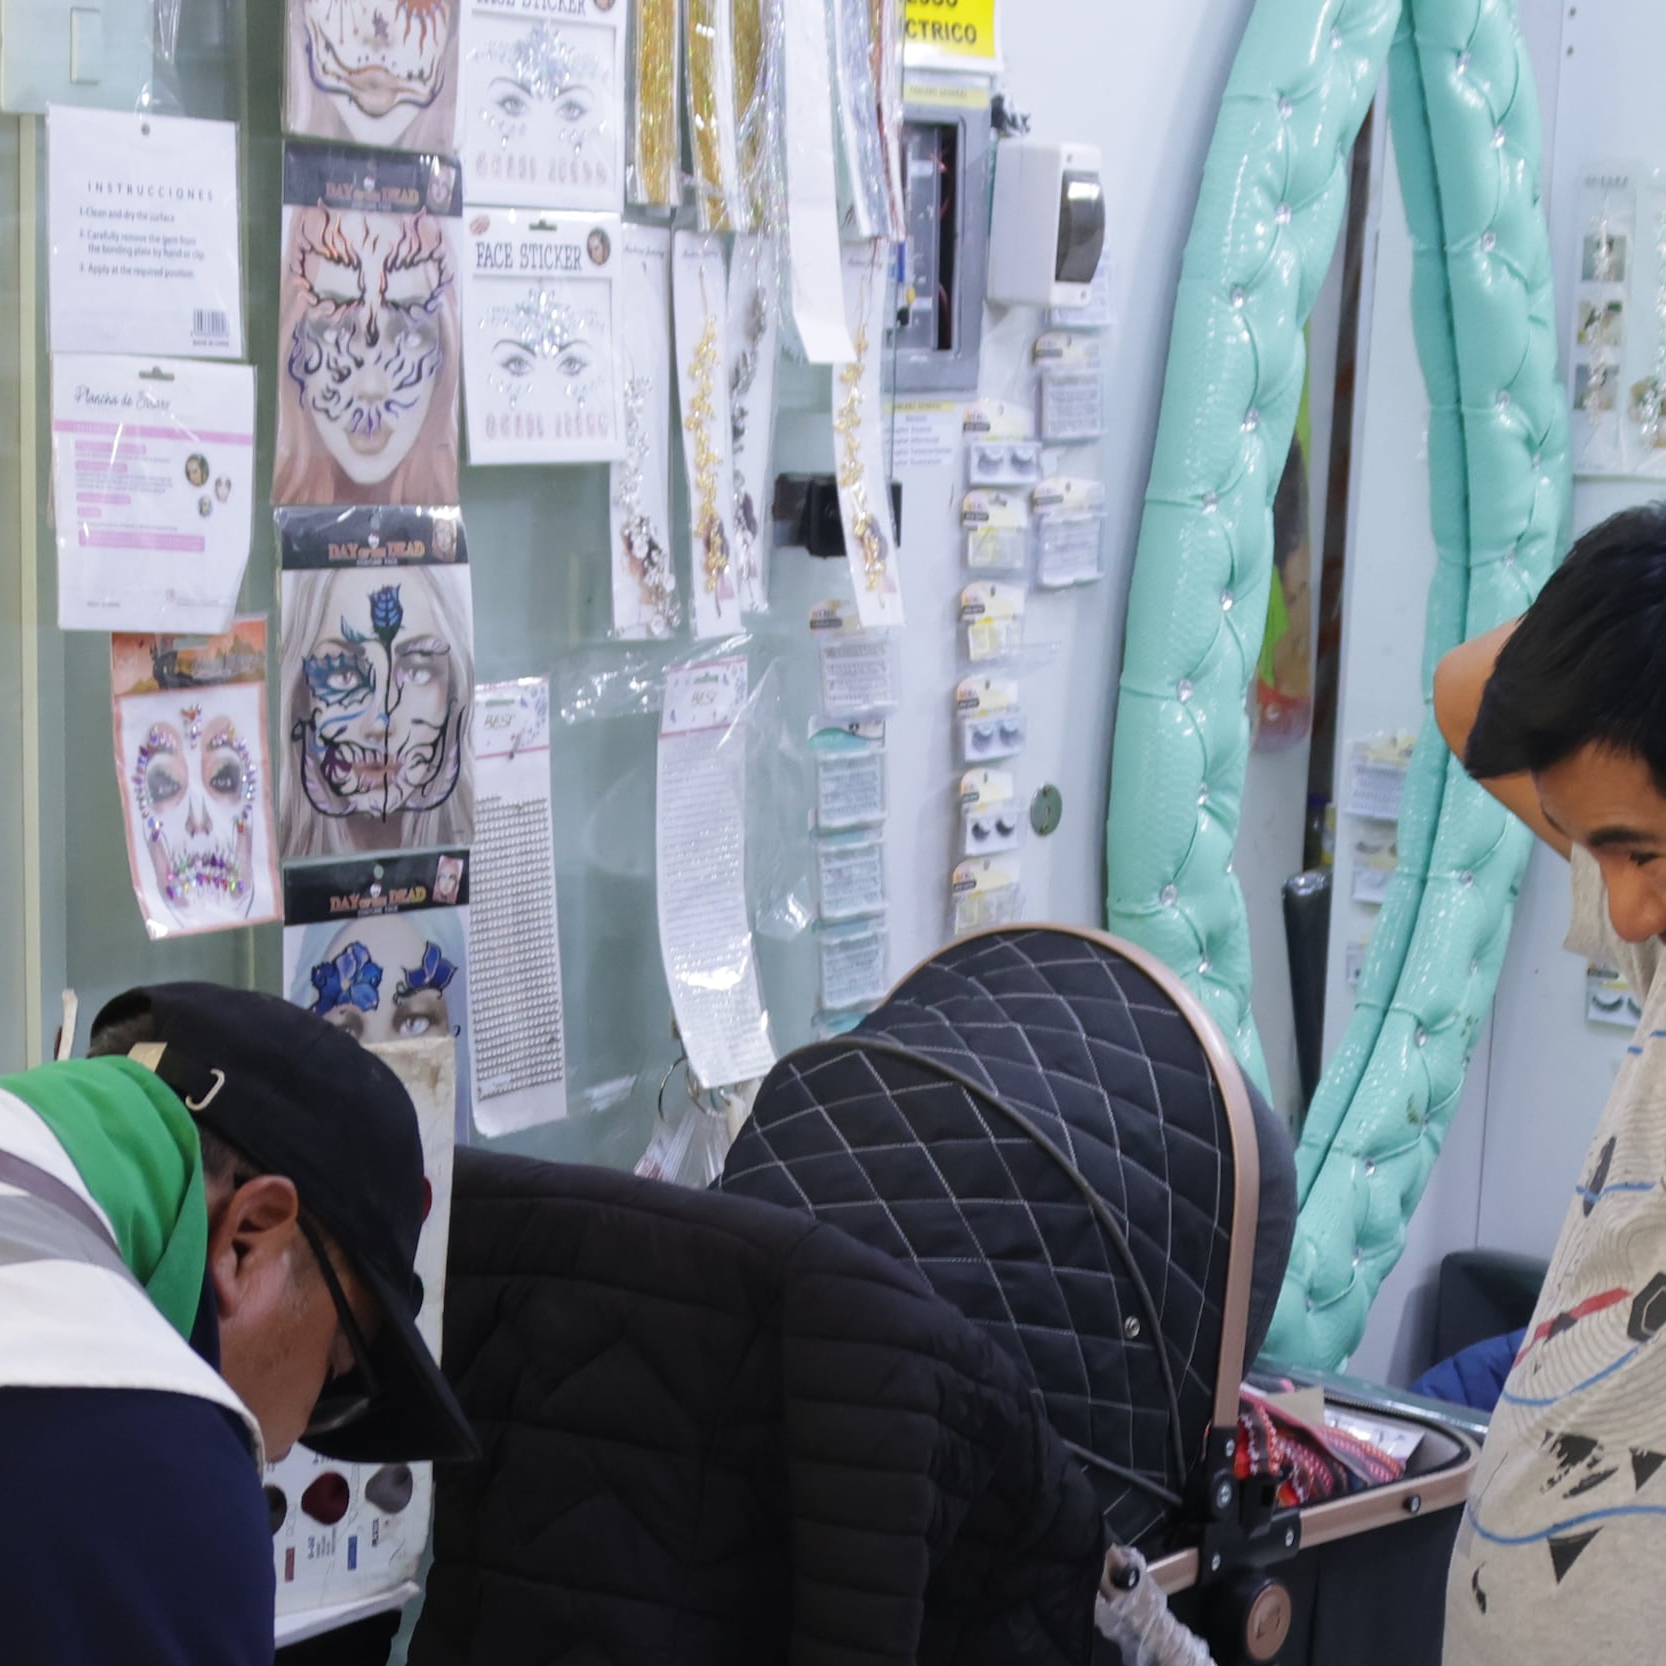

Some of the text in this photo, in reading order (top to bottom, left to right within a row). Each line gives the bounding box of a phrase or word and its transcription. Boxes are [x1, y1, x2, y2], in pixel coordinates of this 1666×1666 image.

[88, 180, 213, 202] INSTRUCCIONES
[476, 242, 581, 271] FACE STICKER
[328, 543, 358, 560] DAY
[387, 540, 425, 558] DEAD
[330, 893, 360, 912] DAY
[389, 886, 426, 905] DEAD
